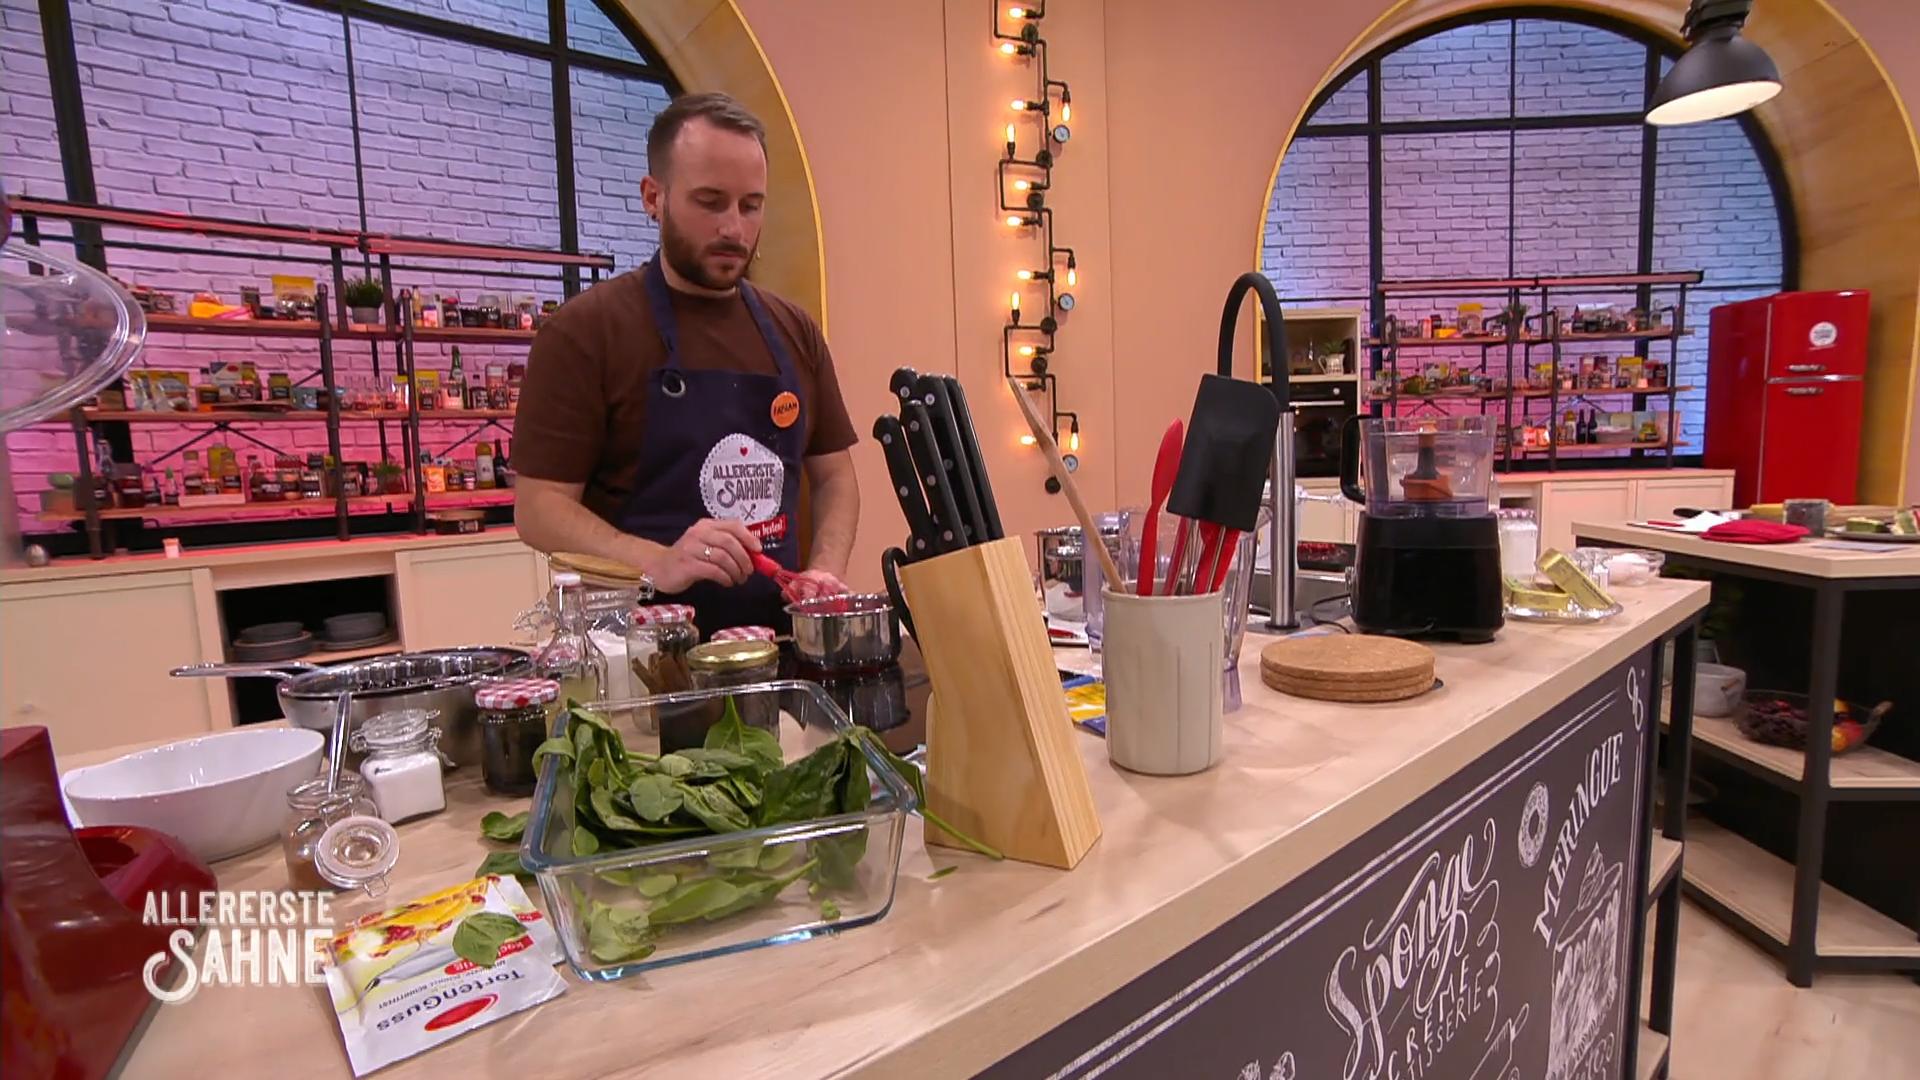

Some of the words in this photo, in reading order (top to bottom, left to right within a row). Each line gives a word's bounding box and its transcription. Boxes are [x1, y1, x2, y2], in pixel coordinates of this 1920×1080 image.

[713, 463, 775, 480] ALLERERSTE
[716, 479, 773, 508] SAHNE
[1533, 731, 1624, 948] MERINGUE
[1325, 817, 1497, 1080] Sponge
[376, 969, 526, 1032] TortenGuss
